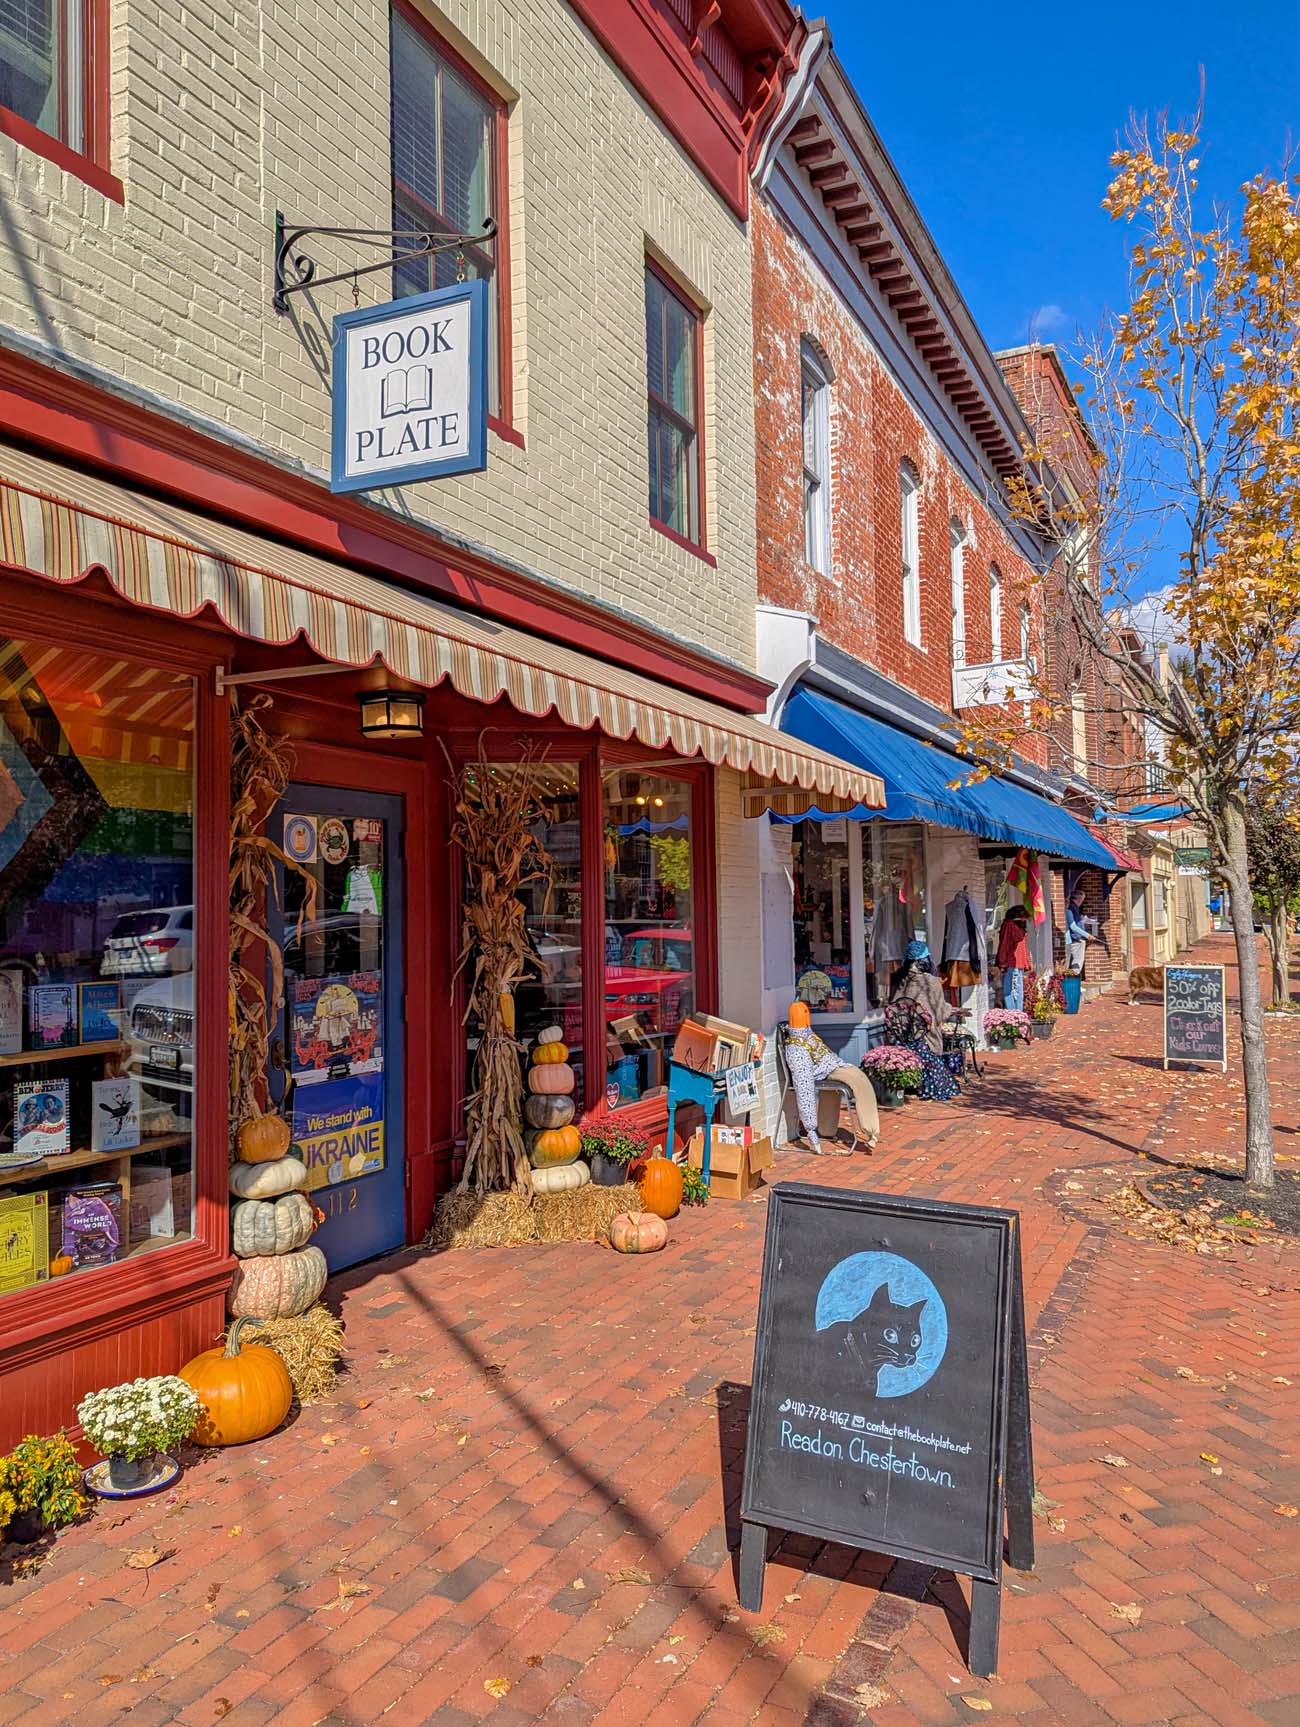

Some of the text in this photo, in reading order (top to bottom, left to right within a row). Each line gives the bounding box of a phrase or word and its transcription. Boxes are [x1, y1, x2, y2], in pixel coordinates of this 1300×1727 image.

[361, 318, 454, 370] BOOK
[354, 412, 461, 463] PLATE
[1168, 980, 1221, 998] 50% off
[1186, 1031, 1206, 1040] our
[18, 1086, 34, 1095] BEN
[41, 1083, 65, 1093] JERRY
[307, 1105, 373, 1132] We stand with
[328, 1187, 359, 1217] 112
[73, 1214, 109, 1225] IMMENSE
[84, 1220, 113, 1230] WORLD
[791, 1401, 850, 1426] 410-778-4167
[848, 1436, 956, 1489] Chestertown.
